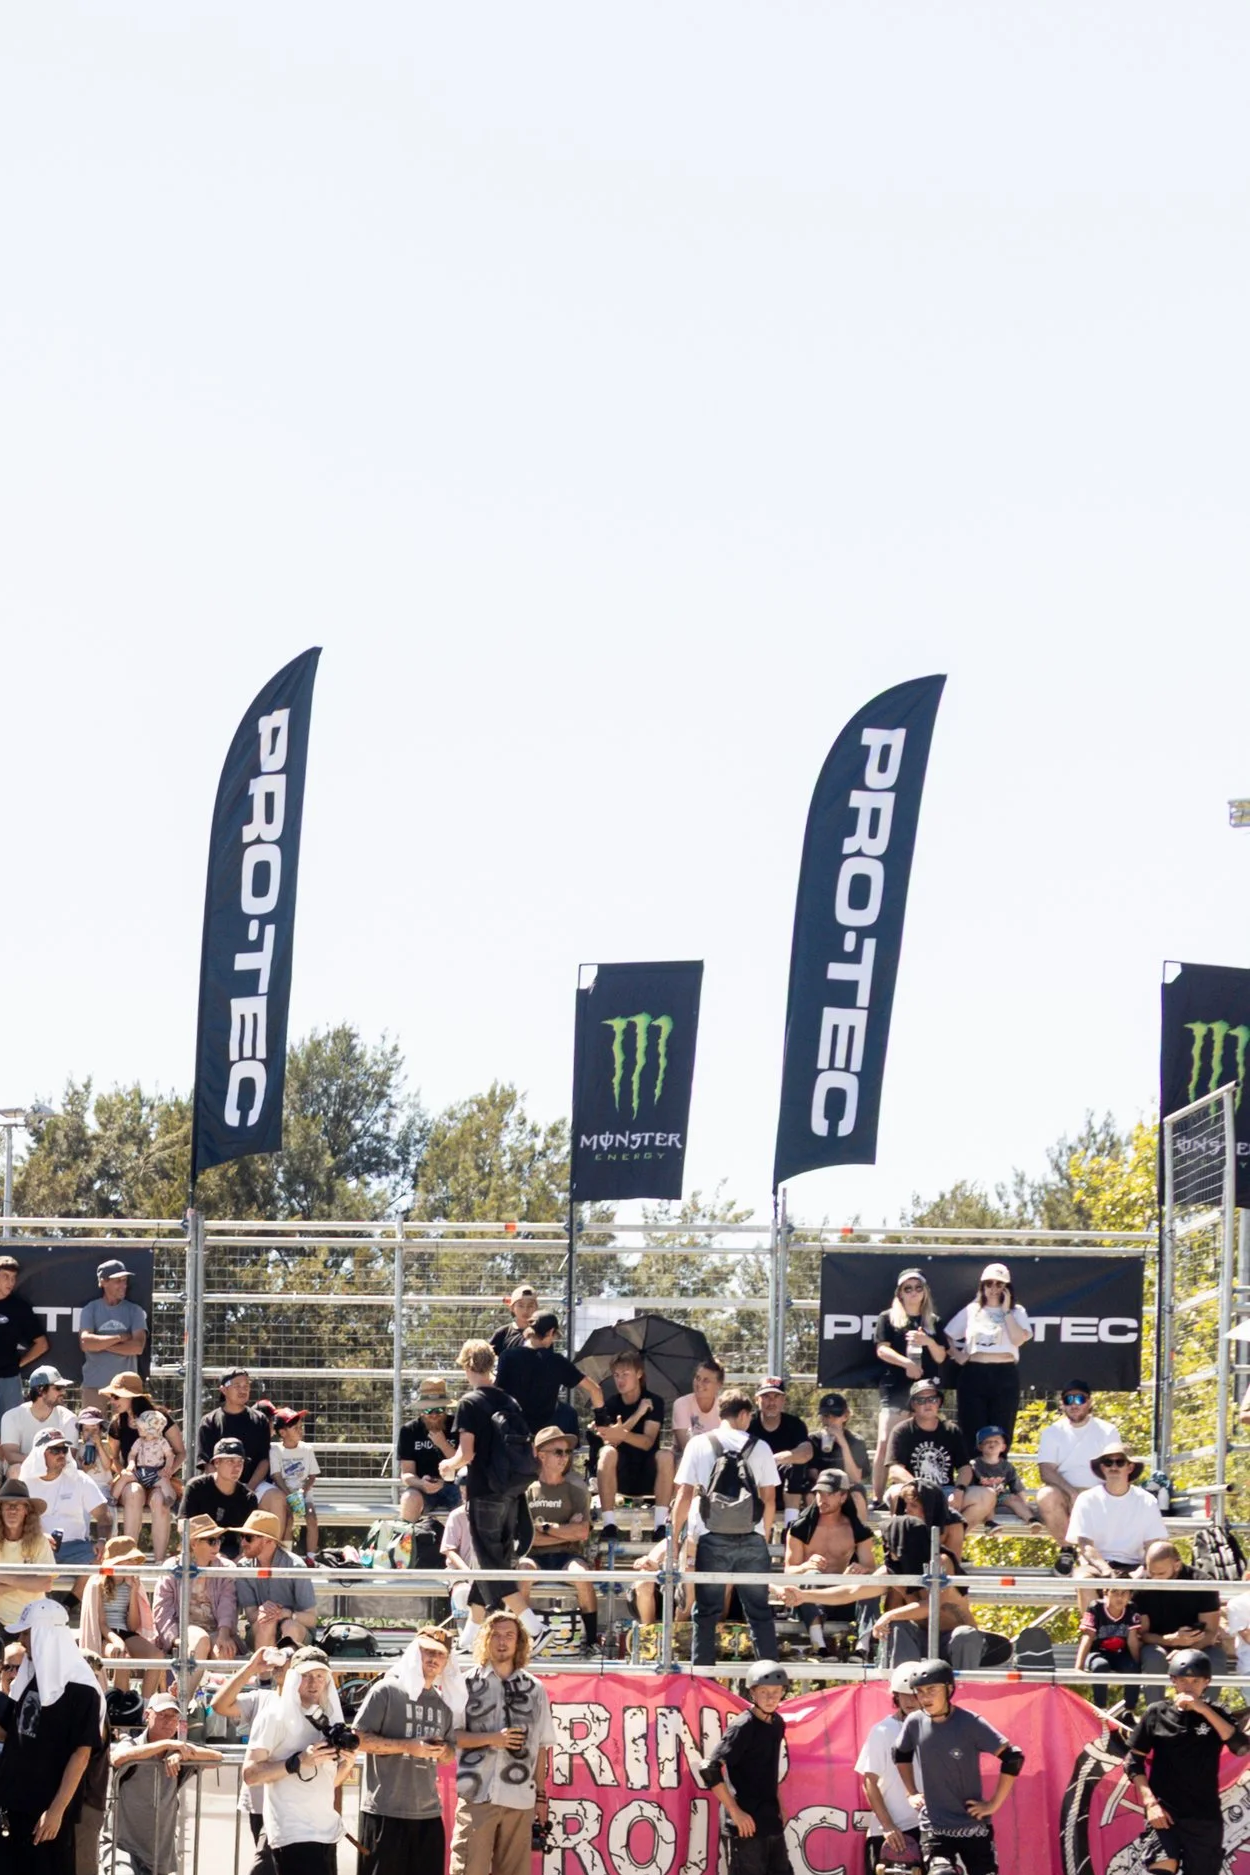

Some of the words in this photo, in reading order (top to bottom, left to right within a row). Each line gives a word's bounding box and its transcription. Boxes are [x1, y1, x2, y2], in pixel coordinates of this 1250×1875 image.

[223, 707, 291, 1128] PRO-TEC
[810, 727, 907, 1138] PRO-TEC
[580, 1129, 683, 1151] MONSTER
[594, 1152, 667, 1162] ENERGY
